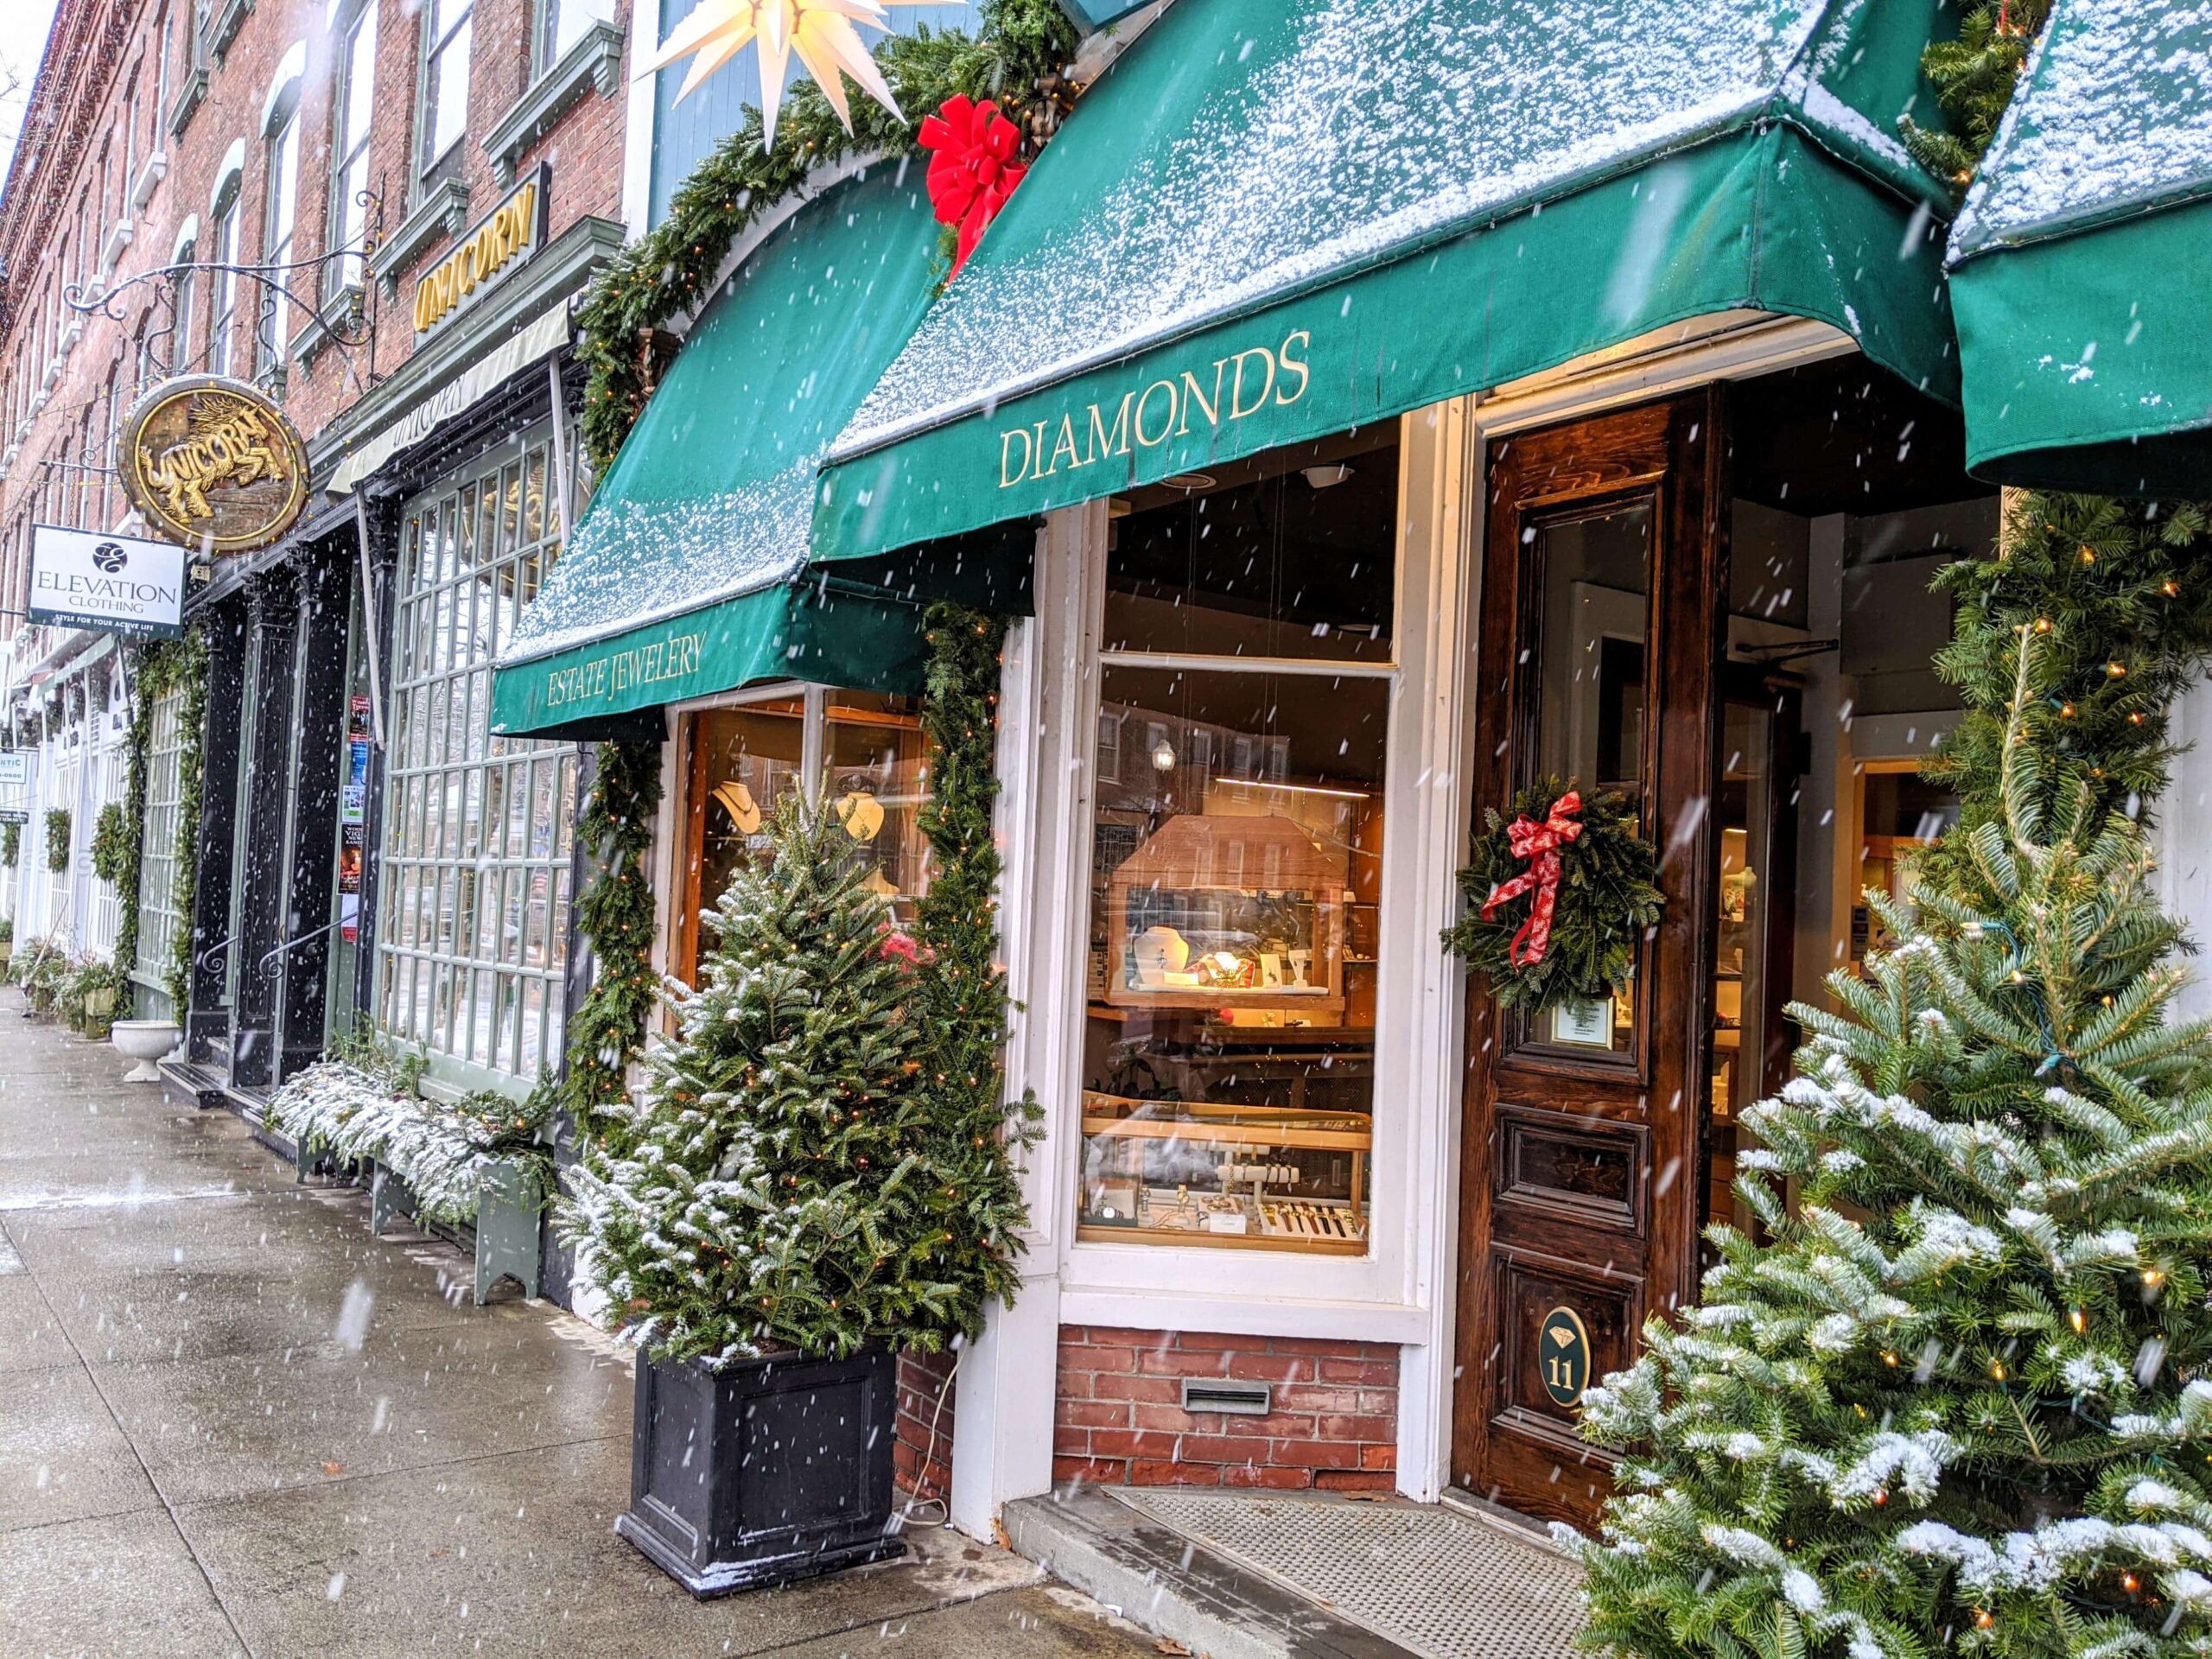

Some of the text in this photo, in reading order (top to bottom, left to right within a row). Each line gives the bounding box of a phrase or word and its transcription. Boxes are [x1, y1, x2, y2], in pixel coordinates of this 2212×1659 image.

[413, 182, 536, 333] UNICORN
[392, 373, 466, 448] UNICORN
[998, 330, 1311, 489] DIAMONDS
[147, 413, 262, 487] UNICORN
[37, 570, 177, 605] ELEVATION
[54, 613, 75, 622] STYLE
[114, 620, 139, 629] ACTIVE
[68, 595, 144, 613] CLOTHING
[546, 631, 707, 707] ESTATE JEWELERY
[1548, 1355, 1574, 1391] 11
